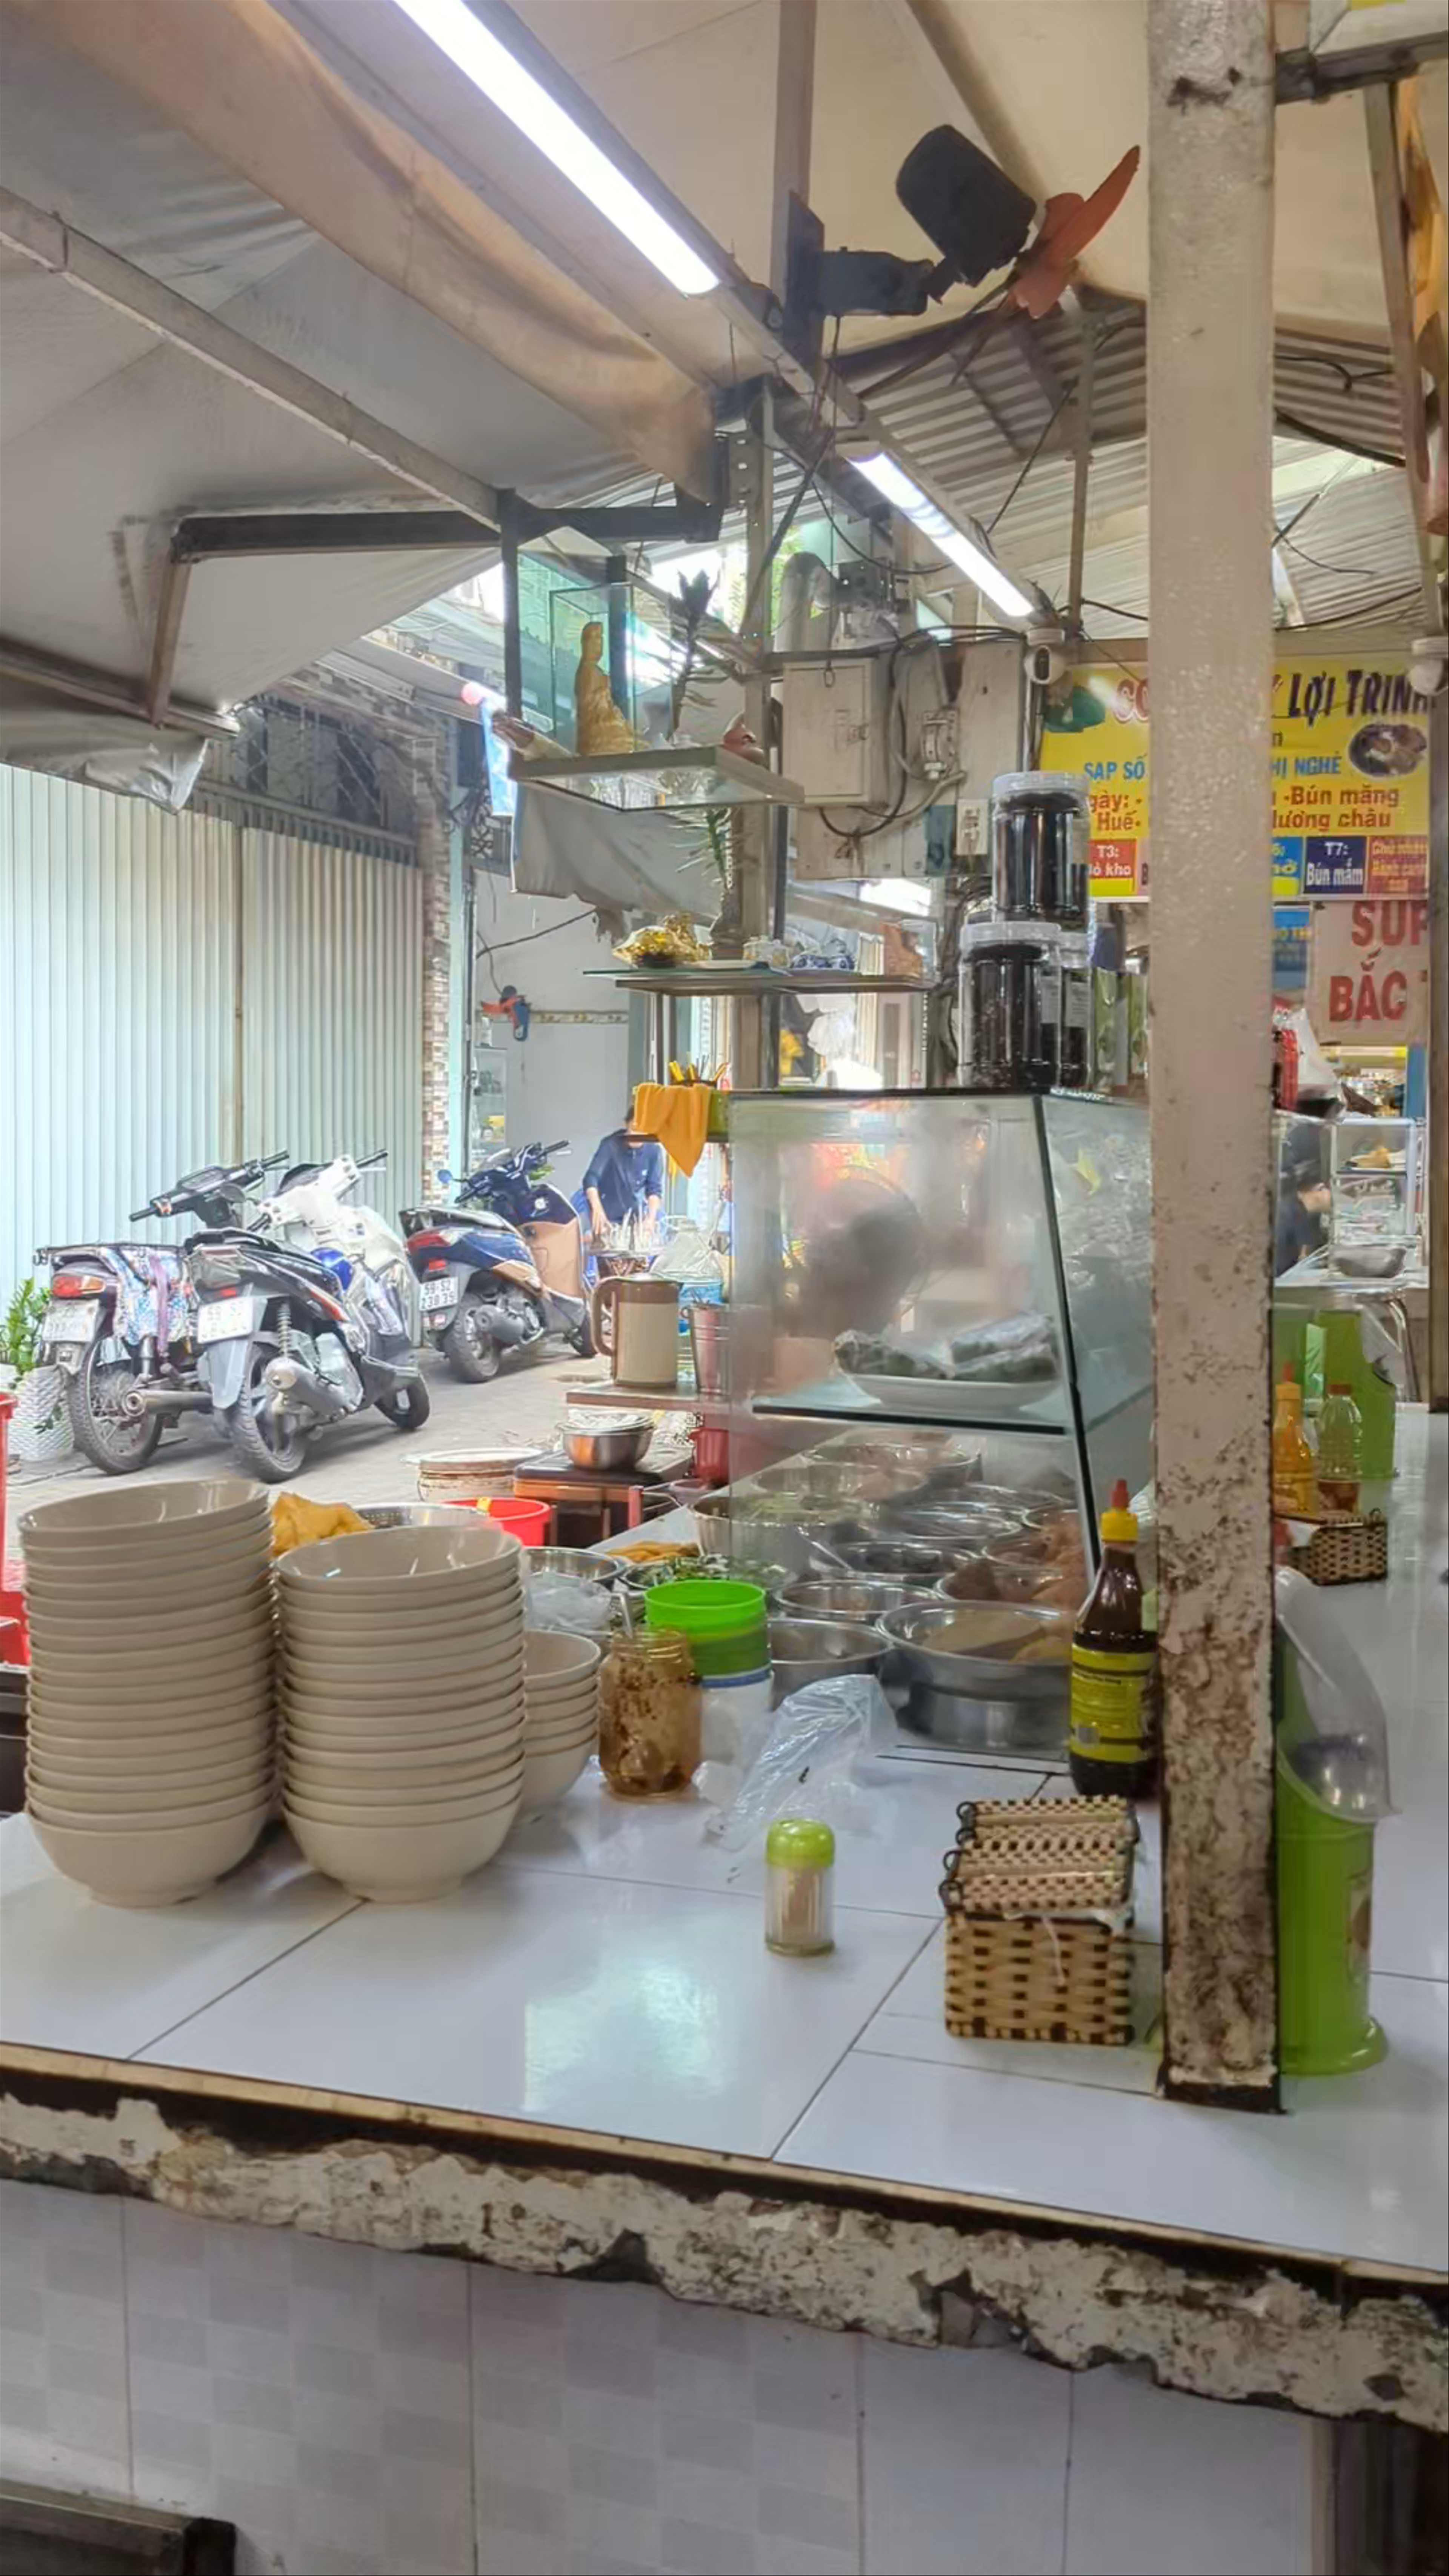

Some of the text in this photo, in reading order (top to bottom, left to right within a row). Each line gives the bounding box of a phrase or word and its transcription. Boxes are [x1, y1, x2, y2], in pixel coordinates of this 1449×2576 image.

[1097, 844, 1120, 858] T3:
[1324, 841, 1349, 856] T7:
[1307, 861, 1330, 886] Bún
[1329, 946, 1407, 1022] BẮC
